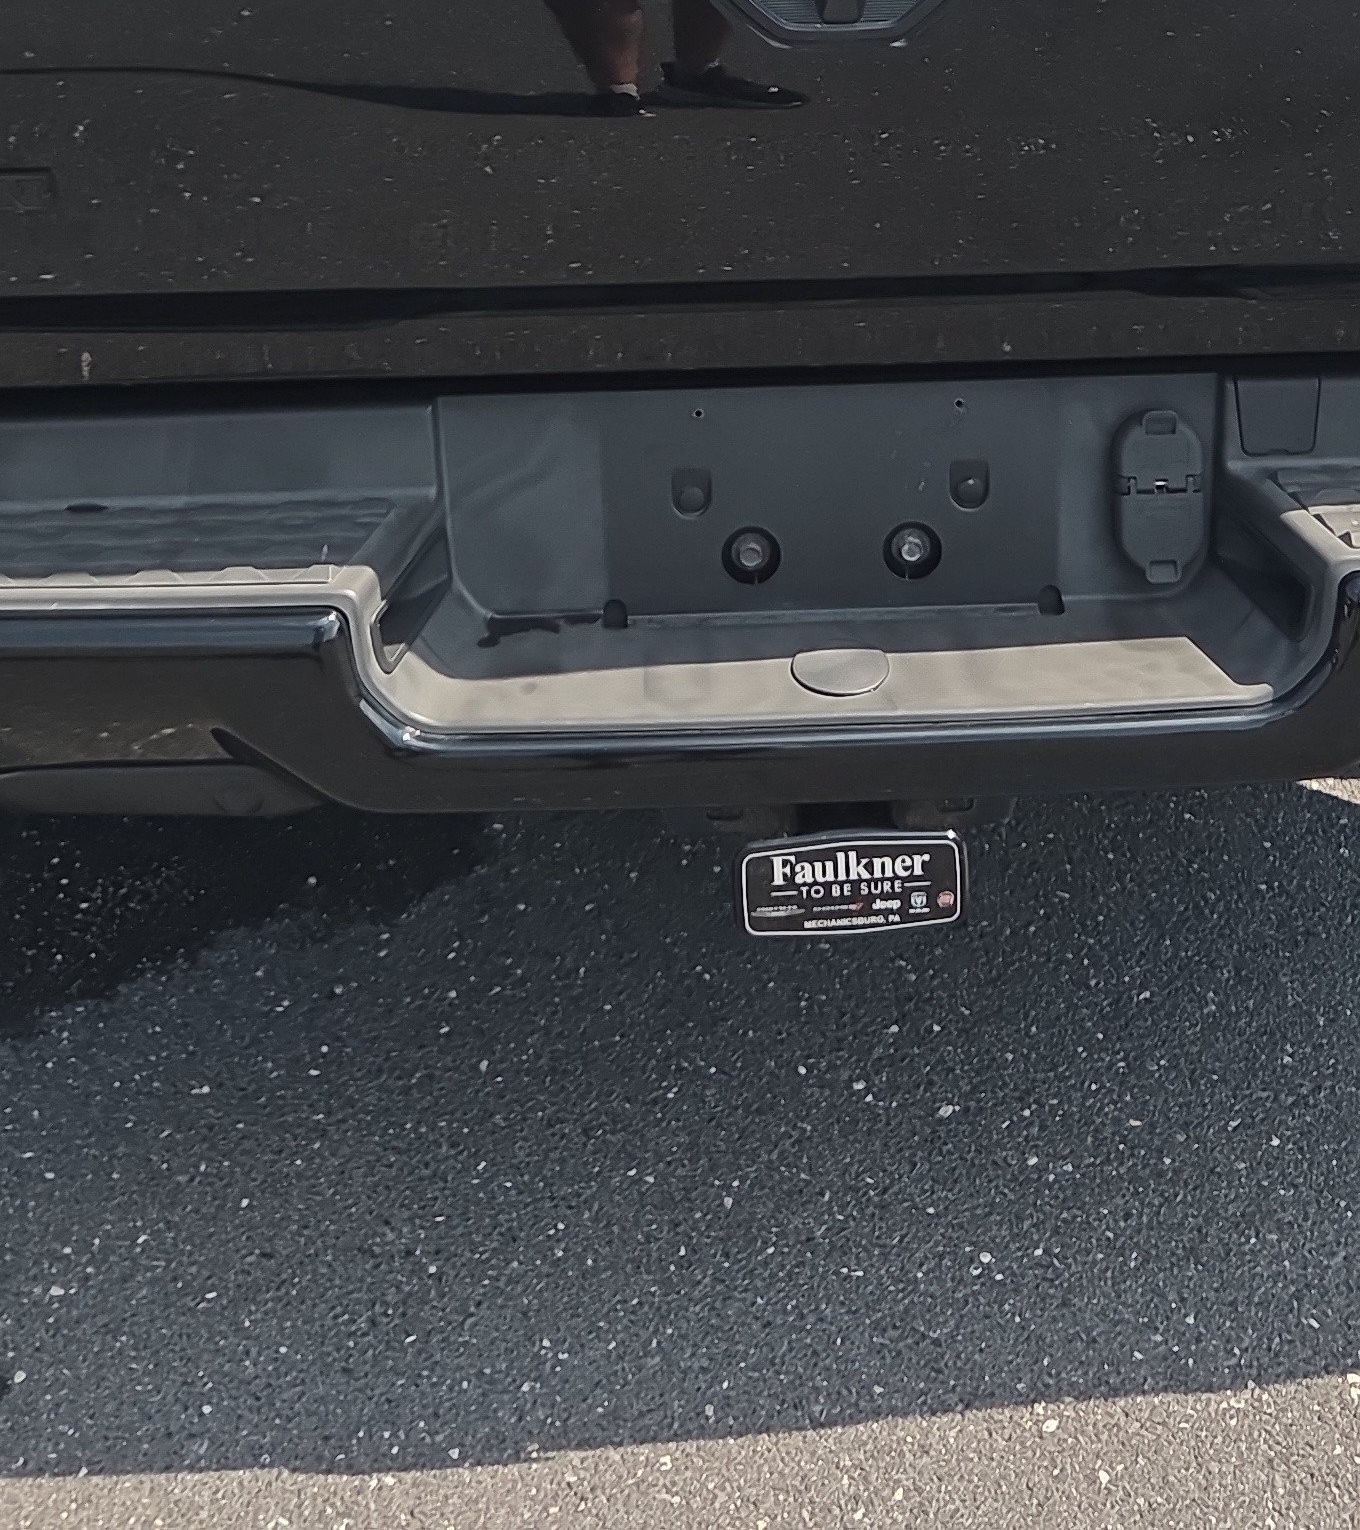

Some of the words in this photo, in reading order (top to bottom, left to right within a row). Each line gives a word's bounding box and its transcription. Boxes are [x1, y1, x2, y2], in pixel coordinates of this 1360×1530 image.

[770, 851, 931, 886] Faulkner
[800, 885, 824, 899] TO
[832, 883, 851, 897] BE
[860, 879, 903, 895] SURE
